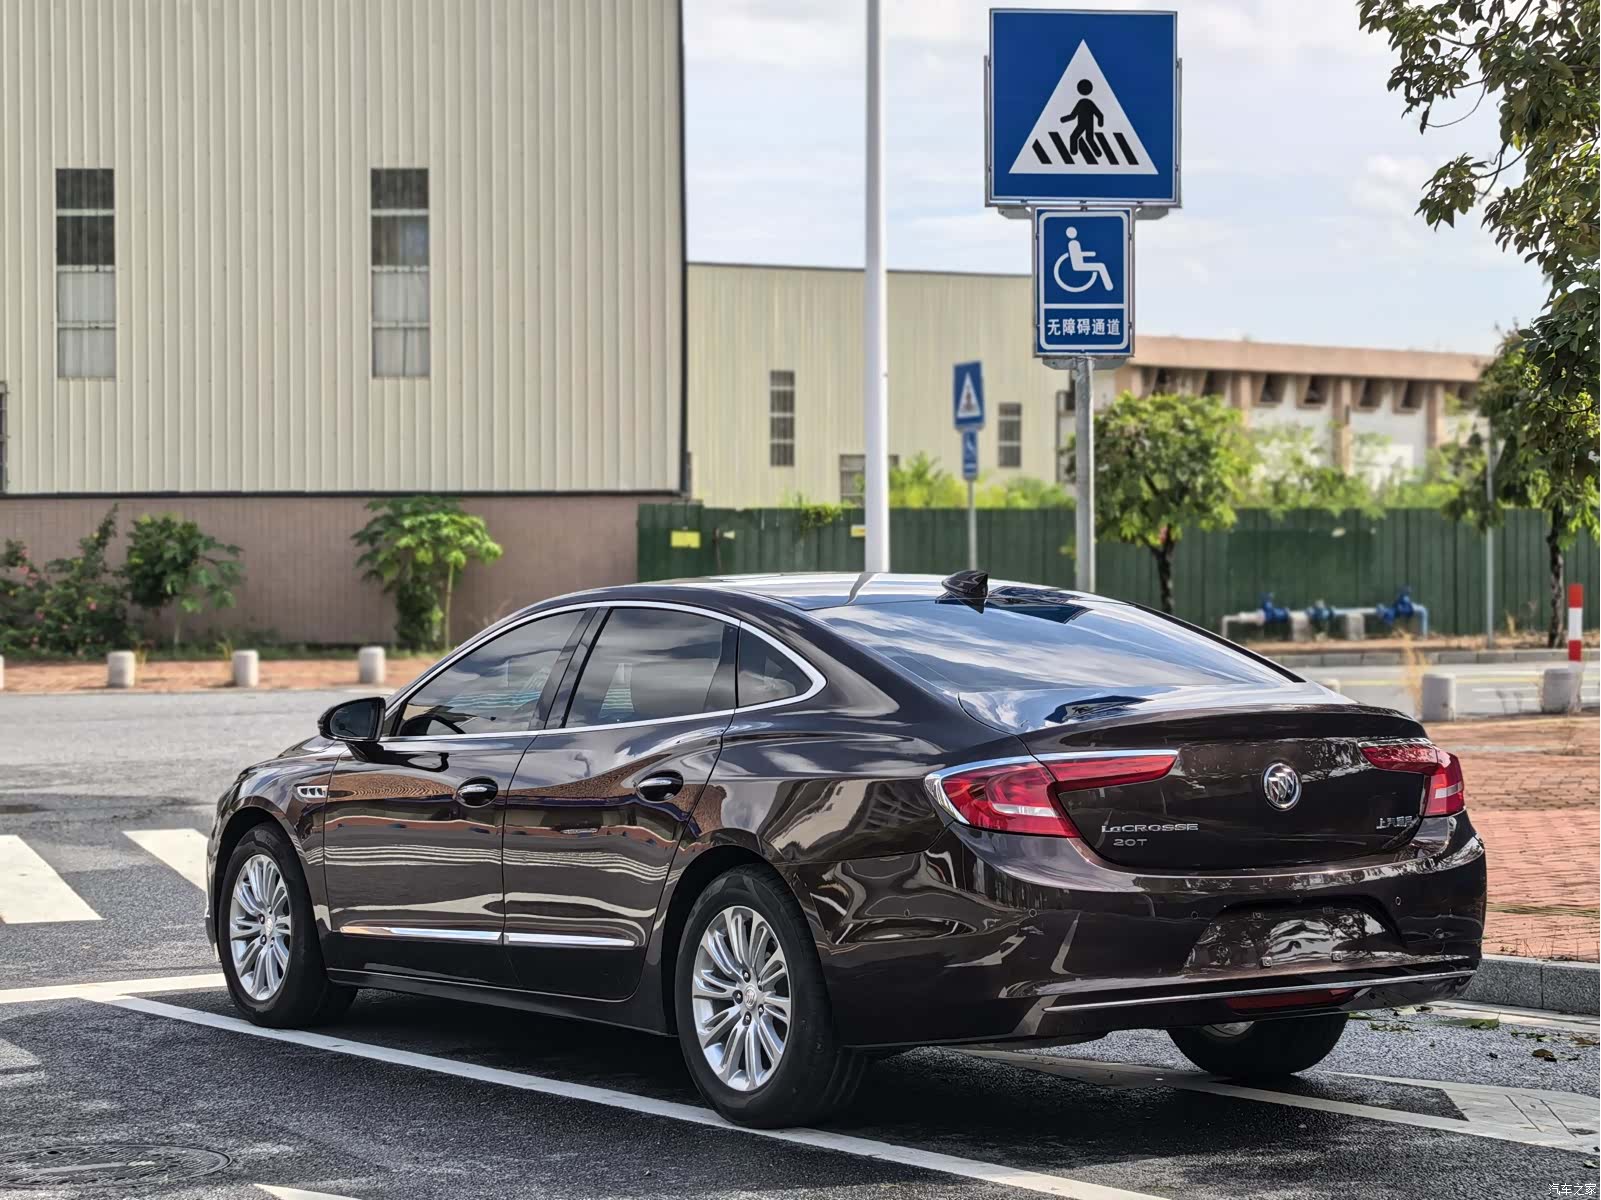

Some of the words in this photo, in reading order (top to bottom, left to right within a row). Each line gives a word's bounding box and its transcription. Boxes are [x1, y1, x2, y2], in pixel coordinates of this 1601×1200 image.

[1047, 318, 1121, 336] 无障碍通道
[1101, 823, 1199, 833] LaCROSSE
[1113, 838, 1148, 847] 20T
